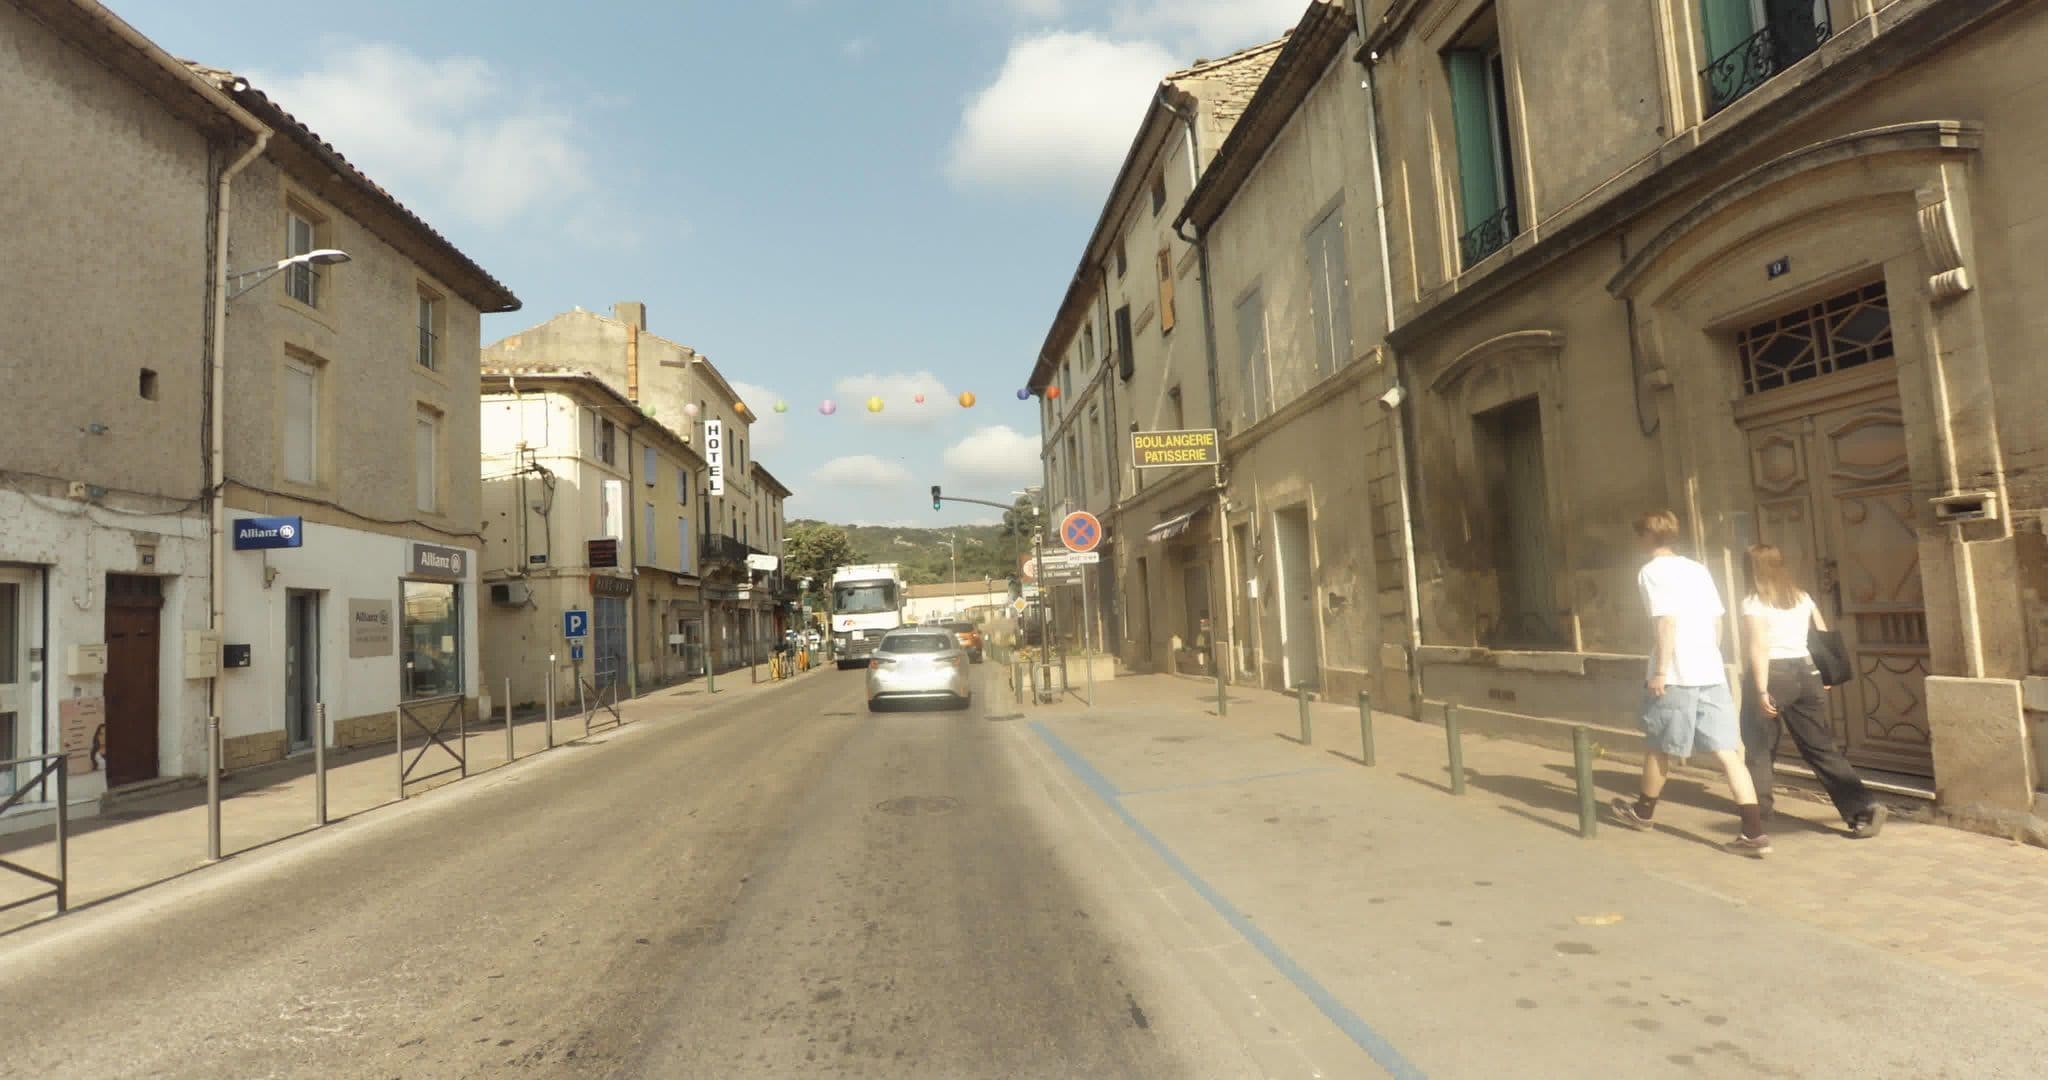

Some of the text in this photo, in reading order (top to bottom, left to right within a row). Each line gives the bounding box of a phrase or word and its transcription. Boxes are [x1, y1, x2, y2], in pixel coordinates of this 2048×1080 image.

[1135, 433, 1214, 448] BOULANGERIE
[708, 425, 720, 490] HOTEL
[1144, 449, 1206, 462] PATISSERIE
[240, 527, 278, 539] Allianz
[421, 551, 450, 569] Allianz
[356, 611, 378, 623] Allianz
[570, 615, 582, 633] P
